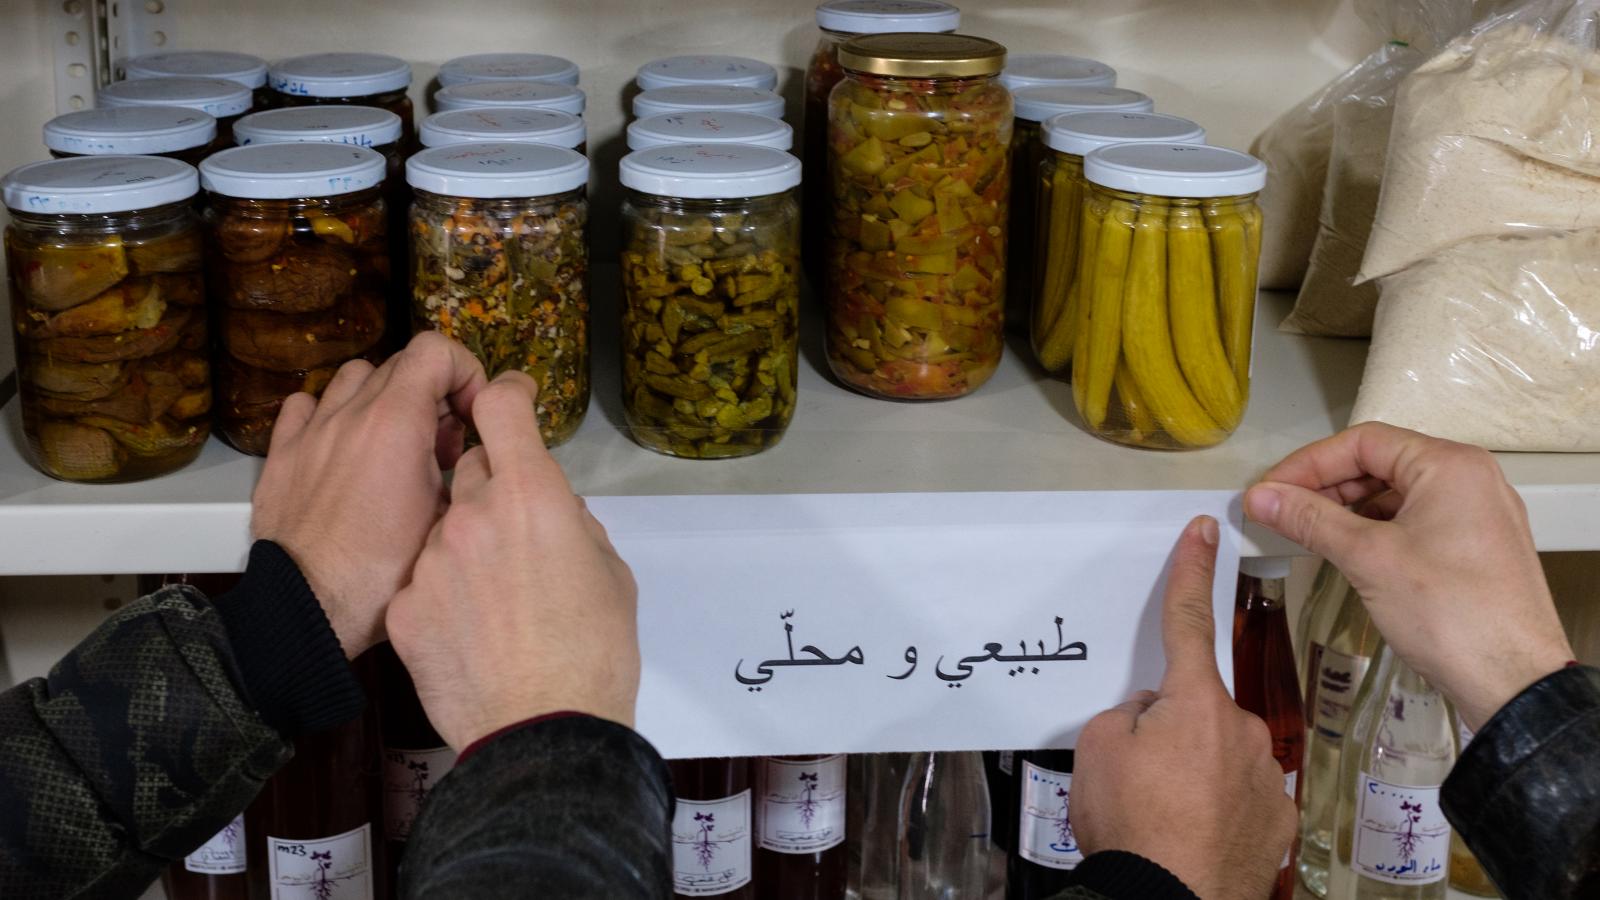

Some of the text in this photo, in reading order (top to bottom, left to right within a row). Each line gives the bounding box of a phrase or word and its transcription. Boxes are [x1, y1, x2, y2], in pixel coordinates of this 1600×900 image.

[735, 609, 1088, 692] طبيعي و محلّي
[277, 844, 307, 856] m23
